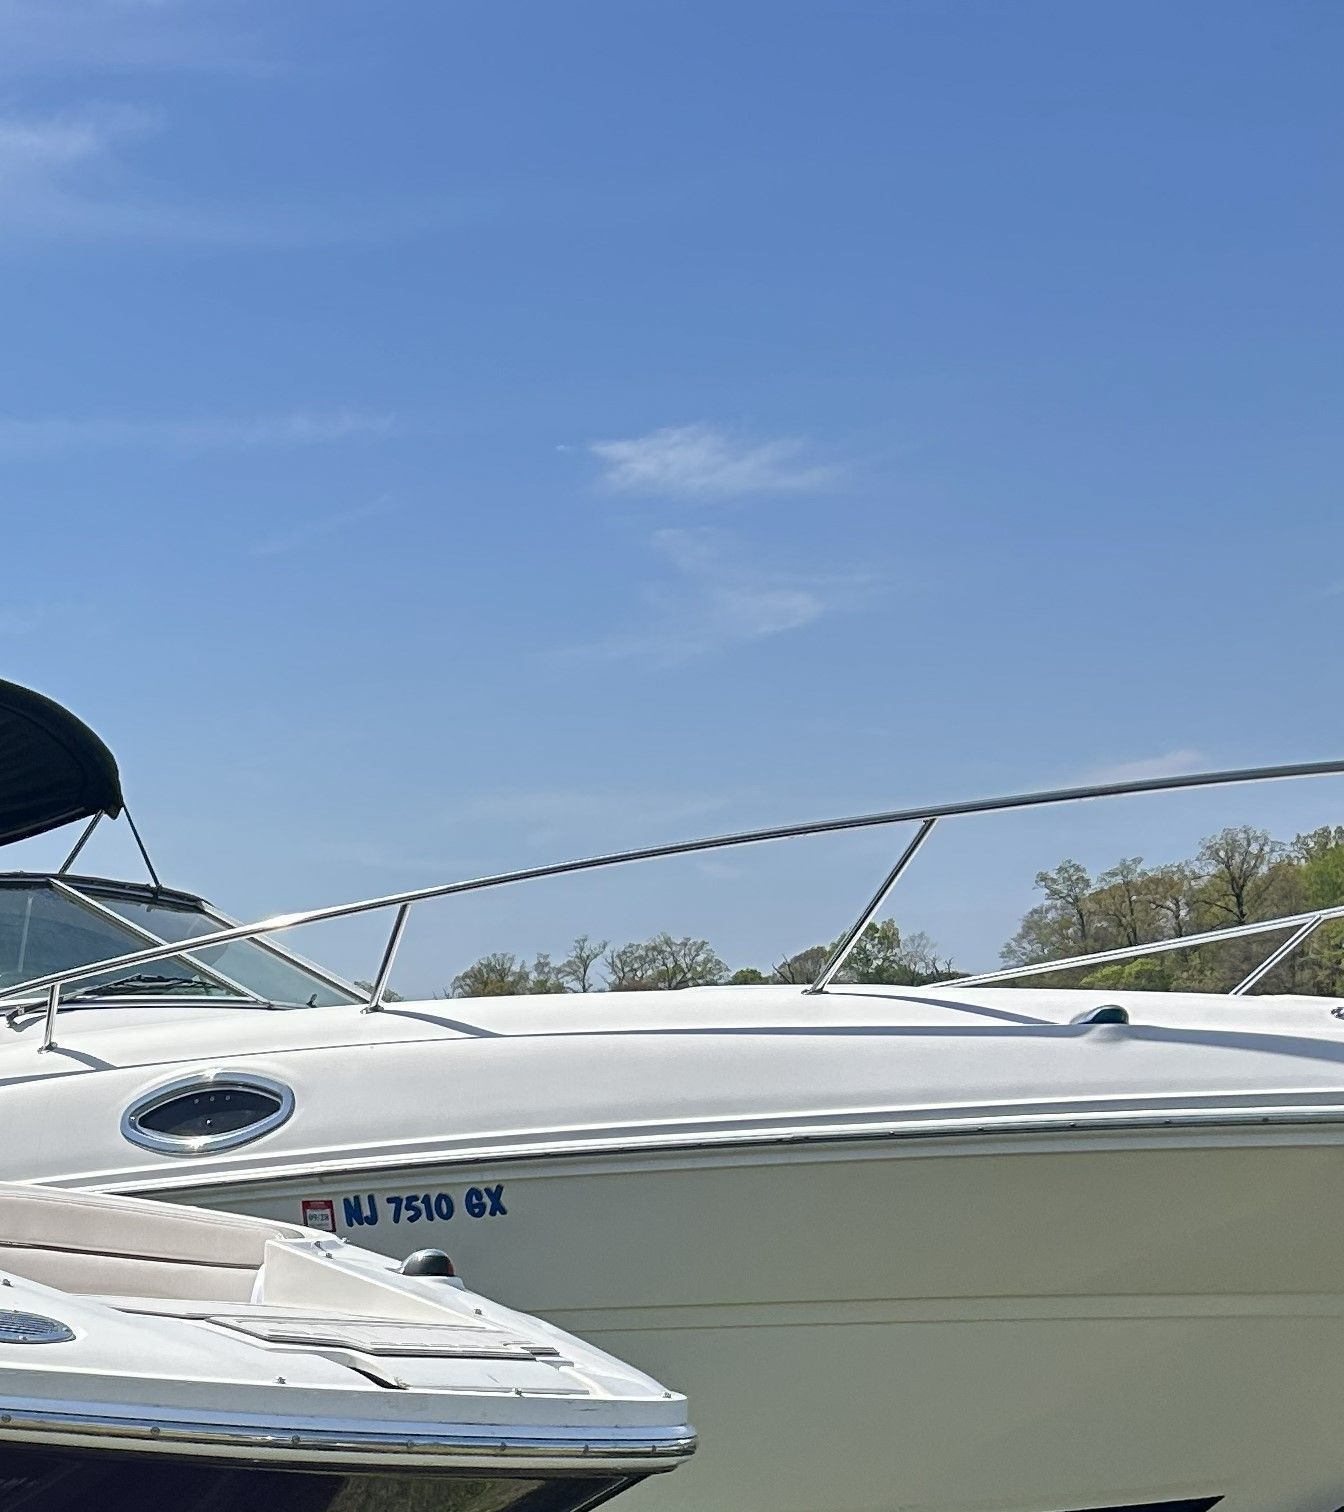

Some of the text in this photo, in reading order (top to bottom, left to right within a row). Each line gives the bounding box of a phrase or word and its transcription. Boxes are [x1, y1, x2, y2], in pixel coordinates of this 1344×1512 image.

[343, 1183, 508, 1228] NJ 7510 GX
